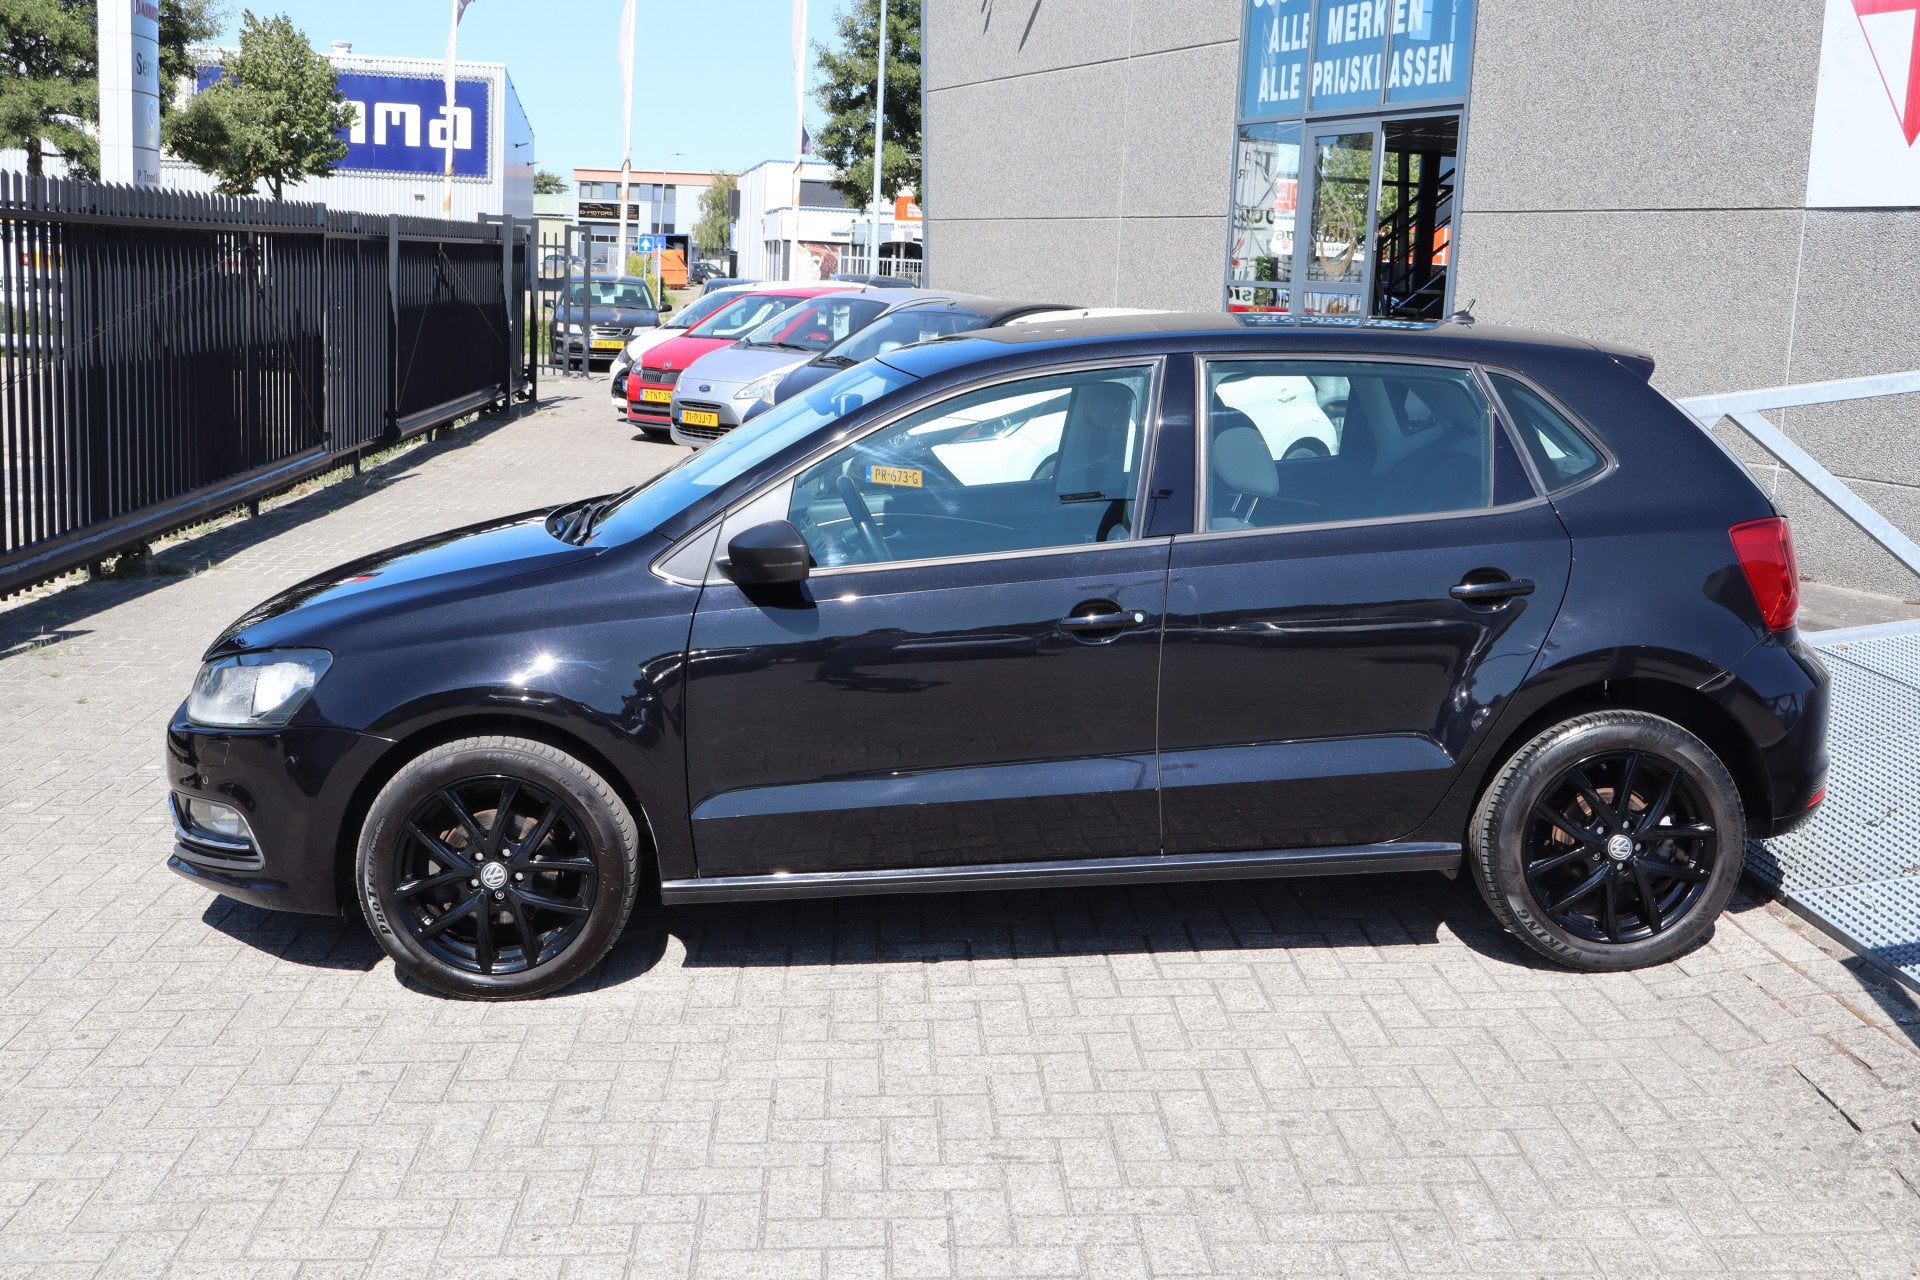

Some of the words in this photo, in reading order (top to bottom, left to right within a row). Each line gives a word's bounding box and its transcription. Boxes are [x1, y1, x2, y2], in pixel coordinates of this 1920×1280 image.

[1268, 12, 1310, 54] ALLE
[1327, 0, 1424, 46] MERKEN
[1257, 63, 1301, 103] ALLE
[1311, 42, 1454, 97] PRIJSKLASSEN
[875, 468, 918, 484] PR-673-G
[1515, 908, 1583, 960] VIKING
